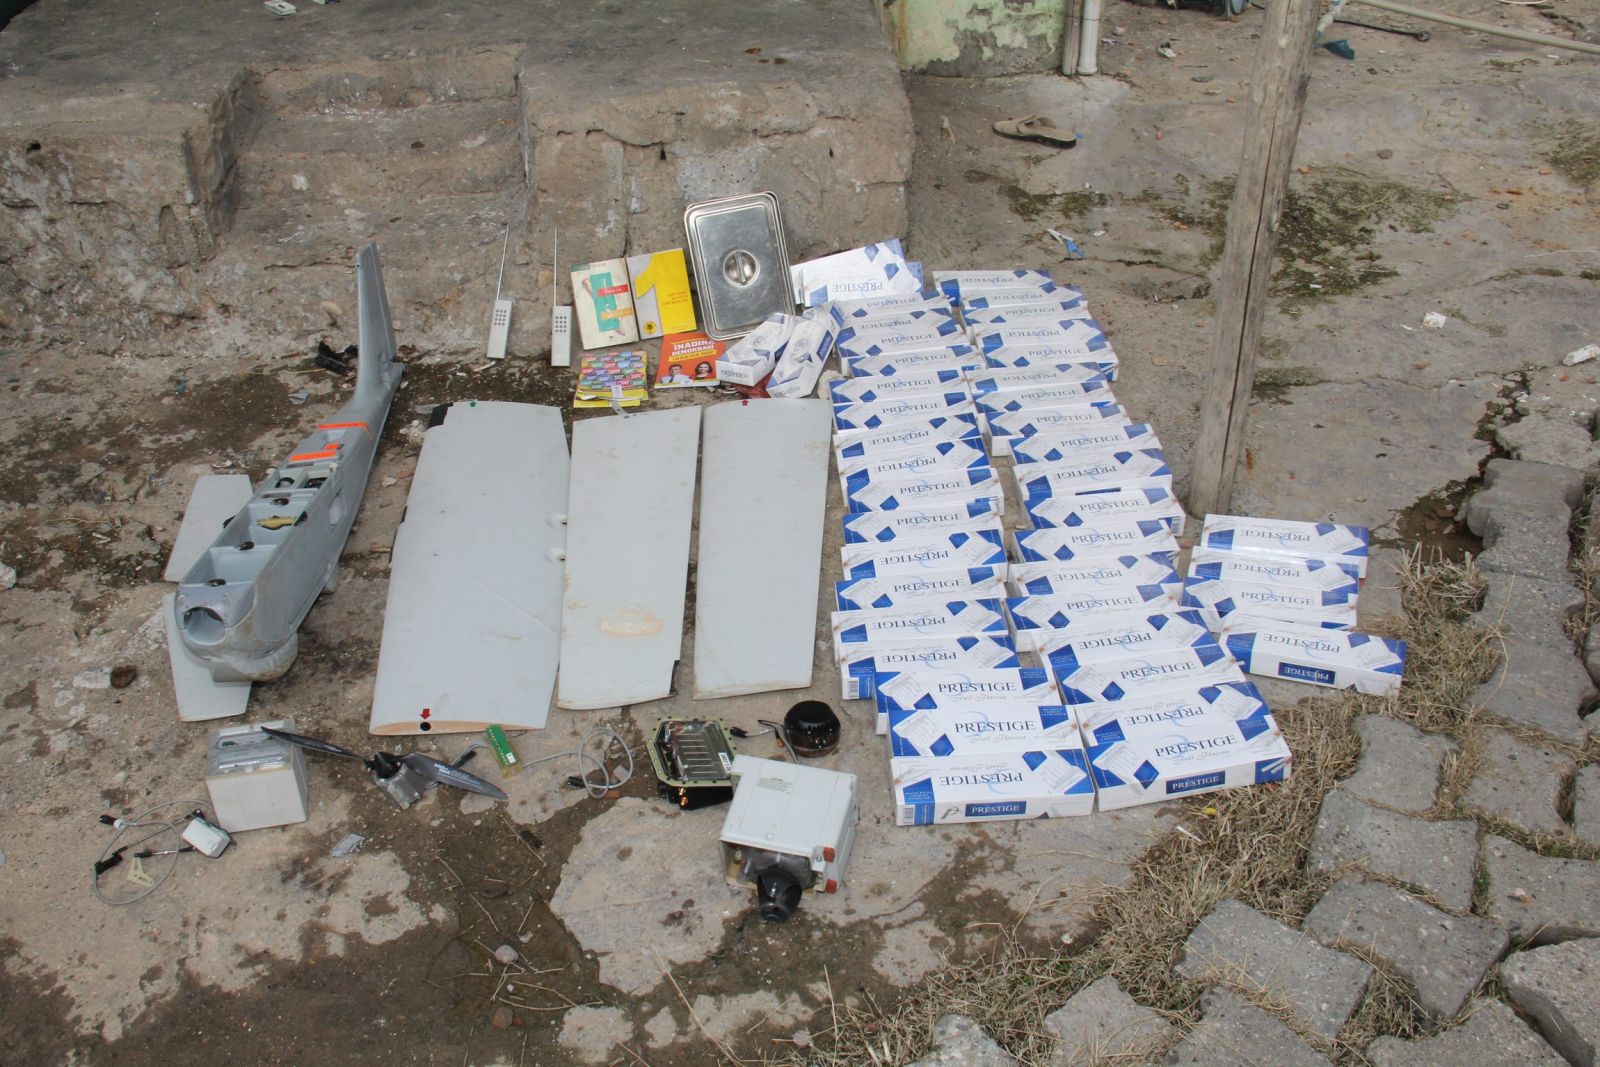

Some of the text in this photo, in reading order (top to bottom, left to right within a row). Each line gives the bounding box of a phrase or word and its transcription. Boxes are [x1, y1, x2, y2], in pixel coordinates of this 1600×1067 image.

[831, 280, 884, 293] PRESTIGE
[881, 333, 937, 344] PRESTIGE
[894, 353, 950, 364] PRESTIGE
[876, 378, 936, 390] PRESTIGE
[1020, 389, 1082, 401] PRESTIGE
[882, 402, 943, 415] PRESTIGE
[1036, 413, 1098, 424] PRESTIGE
[867, 430, 930, 446] PRESTIGE
[1060, 434, 1124, 448] PRESTIGE
[873, 457, 937, 473] PRESTIGE
[899, 480, 966, 495] PRESTIGE
[1079, 498, 1145, 512] PRESTIGE
[896, 512, 965, 527] PRESTIGE
[1071, 531, 1138, 544] PRESTIGE
[1240, 528, 1312, 543] PRESTIGE
[880, 550, 950, 565] PRESTIGE
[1054, 569, 1124, 582] PRESTIGE
[1228, 562, 1301, 578] PRESTIGE
[894, 578, 966, 592] PRESTIGE
[1066, 596, 1138, 611] PRESTIGE
[1240, 591, 1315, 606] PRESTIGE
[872, 616, 947, 630] PRESTIGE
[1079, 632, 1153, 650] PRESTIGE
[1262, 632, 1341, 654] PRESTIGE
[881, 651, 957, 664] PRESTIGE
[1120, 660, 1198, 680] PRESTIGE
[1283, 665, 1330, 681] PRESTIGE
[938, 681, 1017, 693] PRESTIGE
[1126, 706, 1207, 727] PRESTIGE
[955, 720, 1037, 733] PRESTIGE
[1154, 734, 1239, 758] PRESTIGE
[940, 772, 1024, 786] PRESTIGE
[1171, 775, 1221, 791] PRESTIGE
[971, 804, 1020, 814] PRESTIGE
